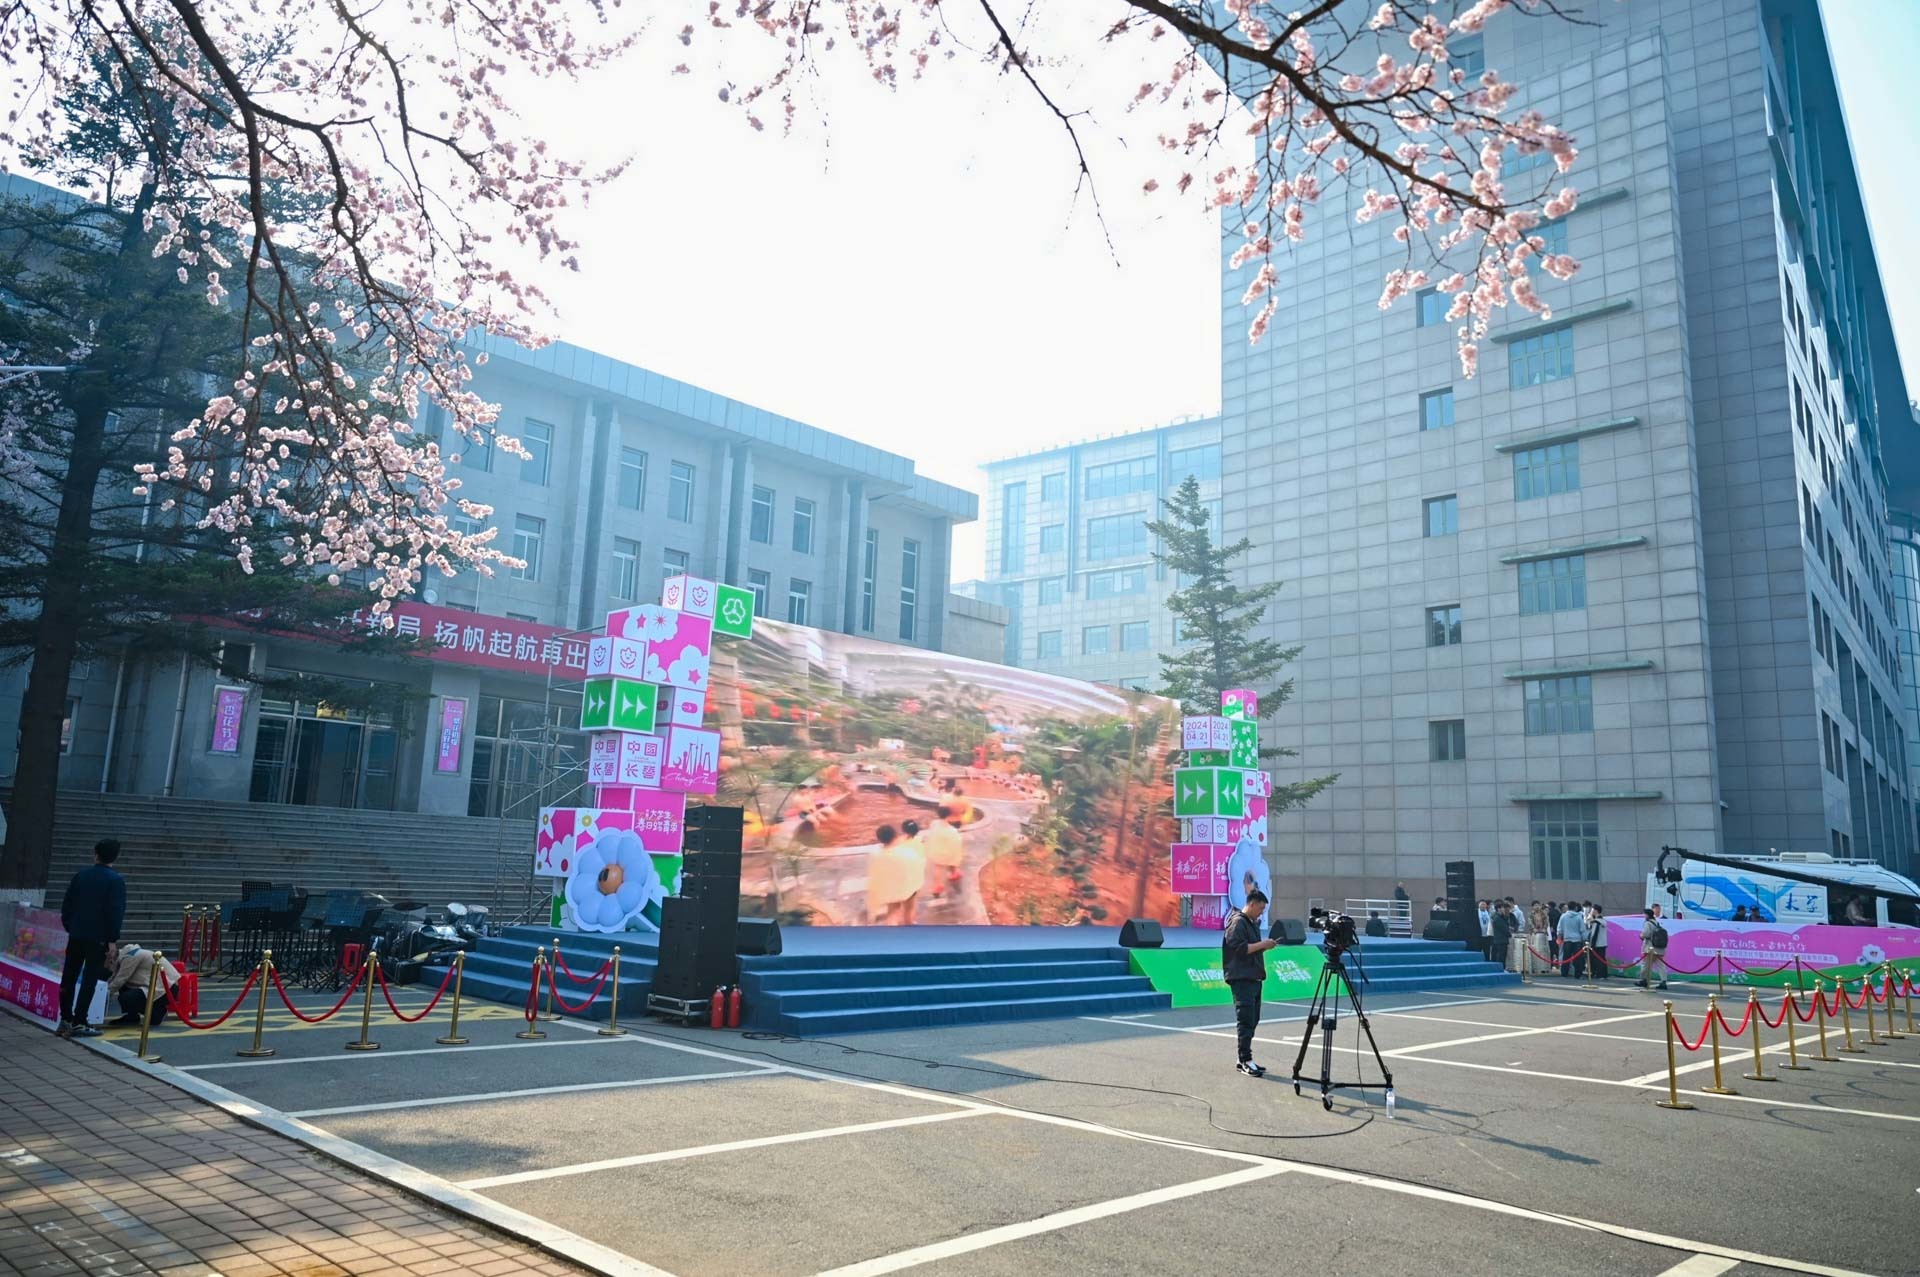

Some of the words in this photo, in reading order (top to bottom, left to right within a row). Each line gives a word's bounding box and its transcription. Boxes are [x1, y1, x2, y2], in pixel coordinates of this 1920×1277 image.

[434, 620, 587, 670] 扬帆起航再出
[1186, 721, 1207, 730] 2024
[1213, 720, 1228, 730] 2024
[594, 739, 617, 754] 中国
[627, 740, 658, 757] 中国
